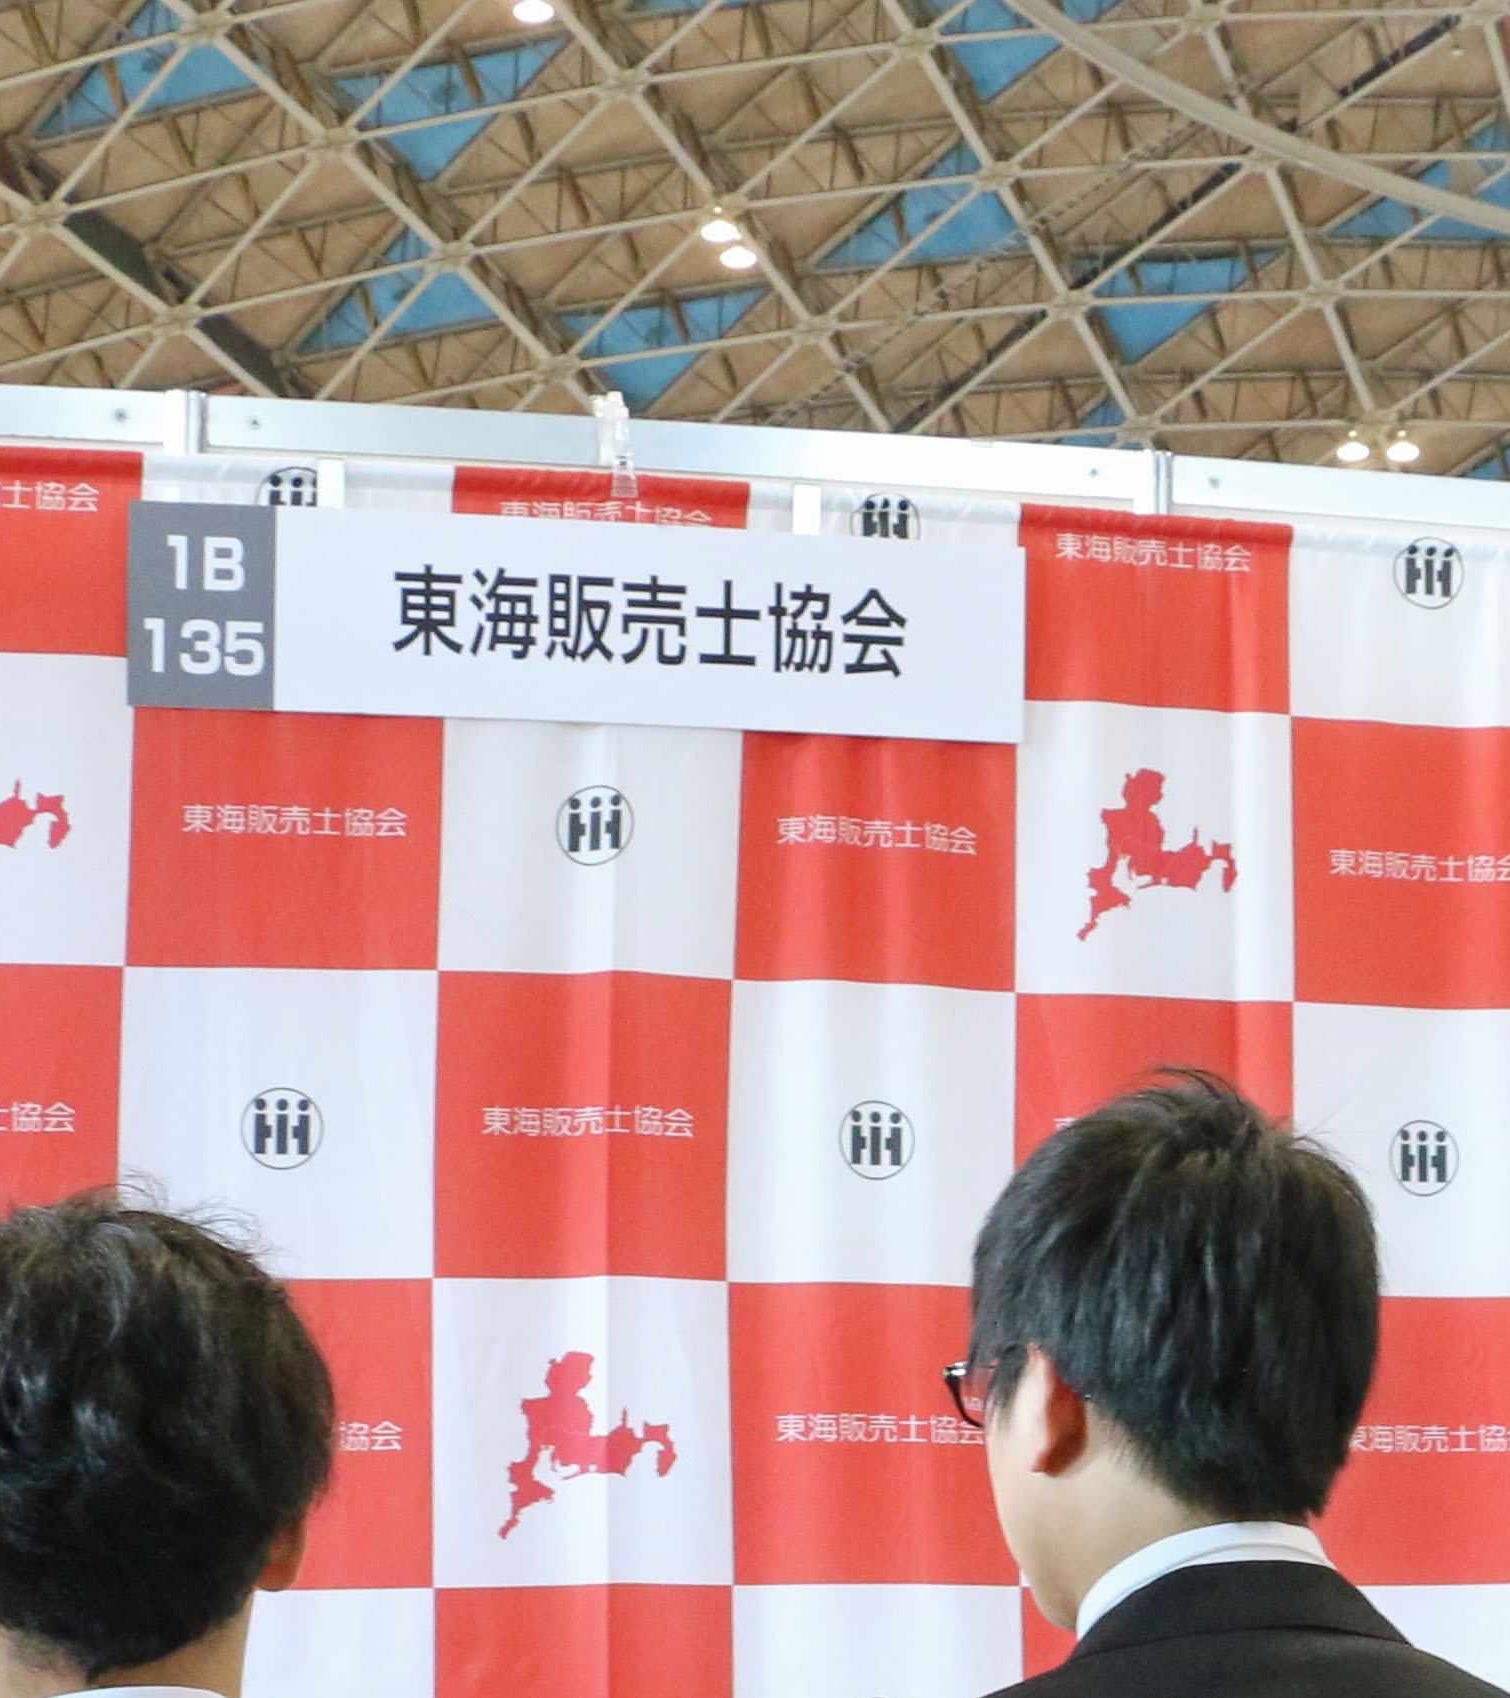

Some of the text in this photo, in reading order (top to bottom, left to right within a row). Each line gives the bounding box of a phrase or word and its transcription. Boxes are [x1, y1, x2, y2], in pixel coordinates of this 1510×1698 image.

[167, 533, 246, 592] 1B
[1055, 532, 1252, 573] 東海販売士協会
[391, 564, 908, 679] 東海販売士協会
[143, 616, 265, 677] 135
[182, 803, 409, 838] 東海販売士協会
[776, 814, 978, 857] 東海販売士協会
[482, 1103, 694, 1139] 東海販売士協会
